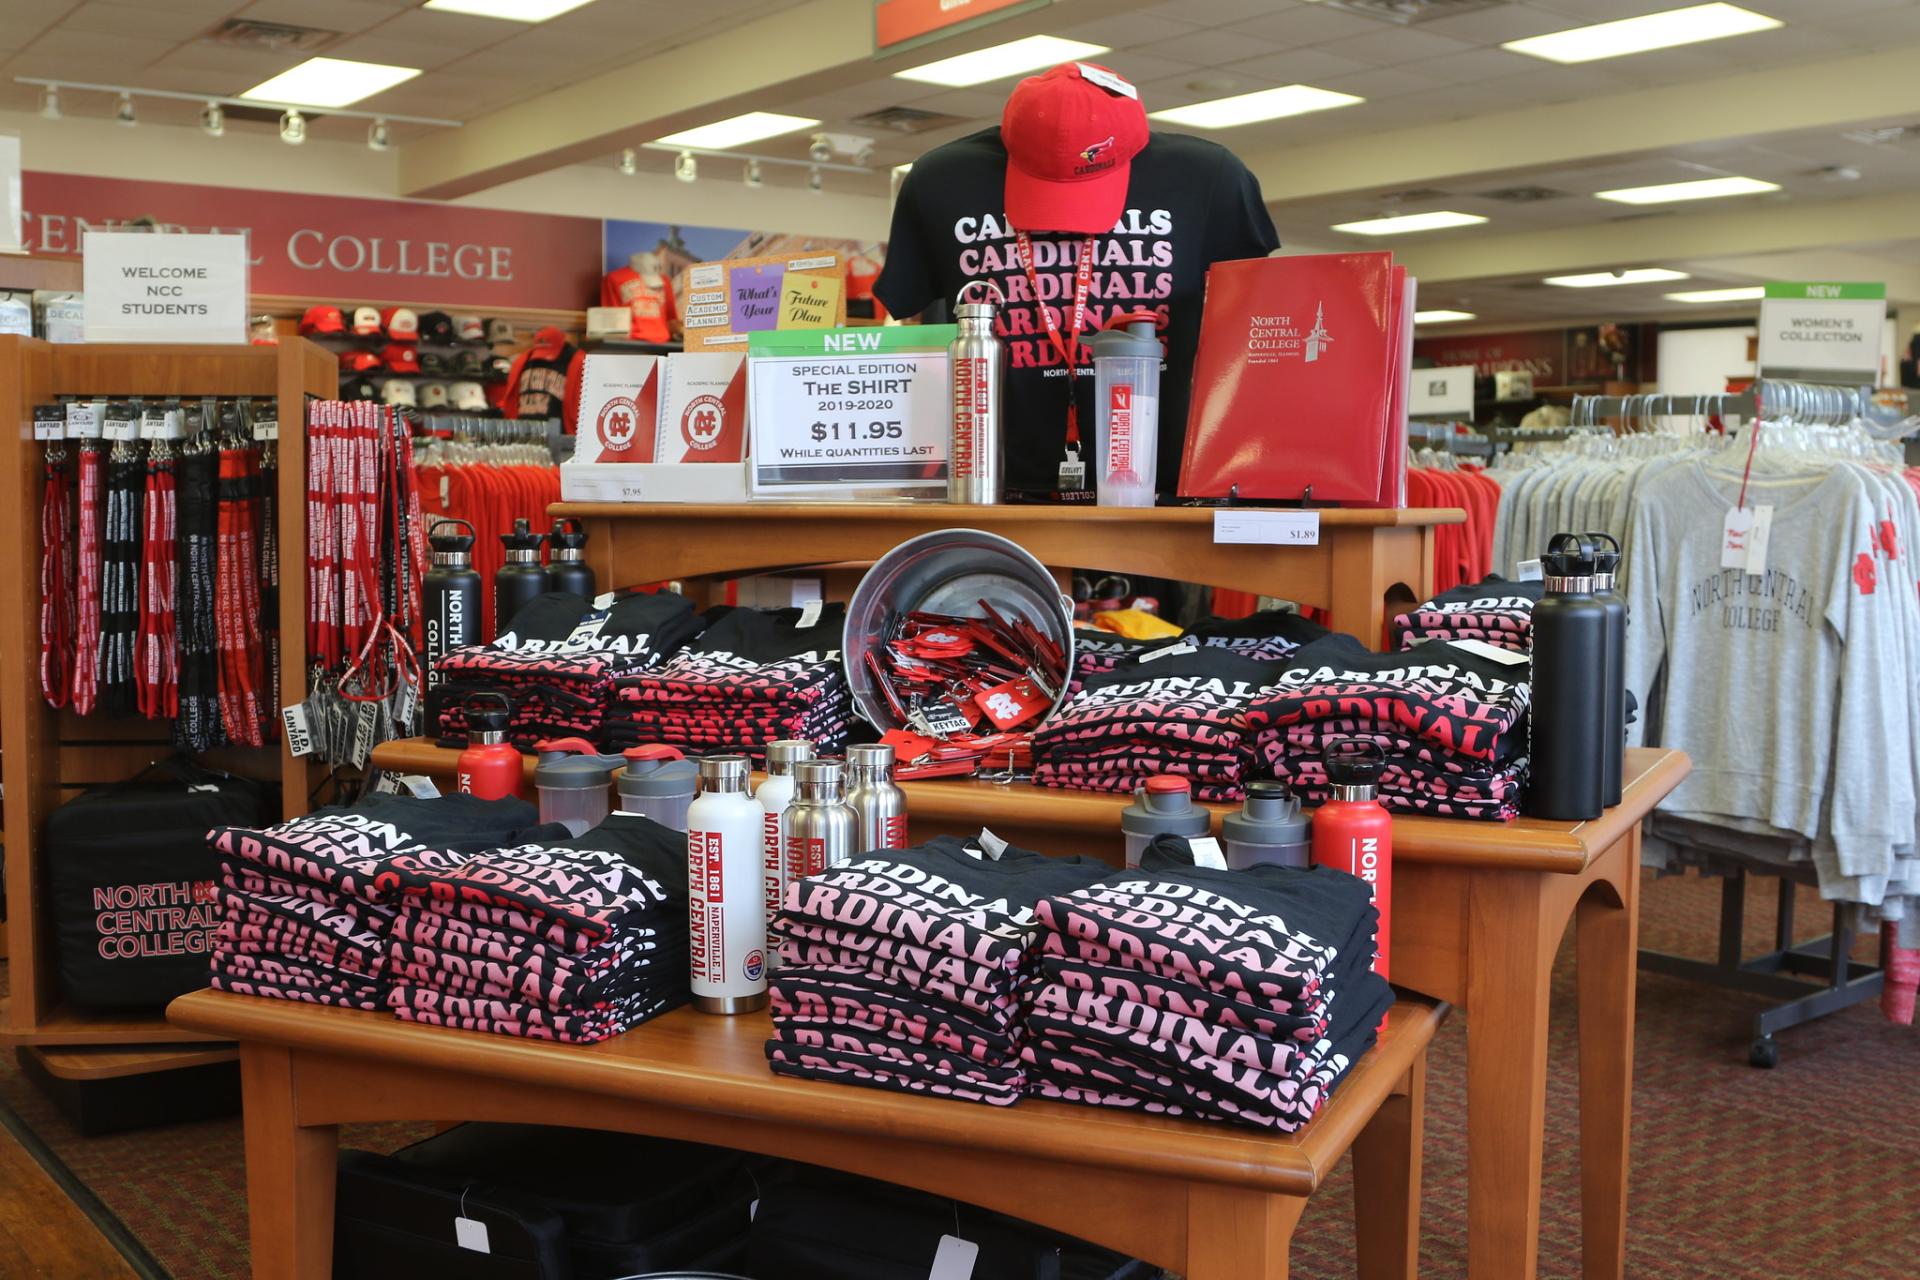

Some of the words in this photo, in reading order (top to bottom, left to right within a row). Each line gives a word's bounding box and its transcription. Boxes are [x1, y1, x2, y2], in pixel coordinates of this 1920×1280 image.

[954, 208, 1174, 244] CAALS
[287, 229, 514, 281] COLLEGE
[959, 238, 1174, 276] CARDINALS
[122, 267, 207, 279] WELCOME
[146, 286, 182, 297] NCC
[1806, 285, 1841, 297] NEW
[122, 304, 208, 315] STUDENTS
[740, 304, 774, 320] Your
[788, 307, 822, 323] Plan
[1074, 284, 1089, 330] NORTH
[1250, 316, 1290, 326] NORTH
[823, 333, 882, 352] NEW
[1248, 339, 1300, 350] COLLEGE
[1249, 328, 1301, 338] CENTRAL
[1779, 331, 1863, 342] COLLECTION
[792, 365, 855, 376] SPECIAL
[858, 363, 917, 374] EDITION
[955, 358, 972, 407] NORTH
[847, 379, 912, 395] SHIRT
[600, 398, 618, 418] NORTH
[619, 398, 640, 418] CENTRAL
[685, 396, 704, 417] NORTH
[704, 396, 726, 416] CENTRAL
[817, 399, 893, 411] 2019-2020
[604, 441, 632, 451] COLLEGE
[689, 440, 717, 450] COLLEGE
[810, 420, 903, 443] $11.95
[955, 412, 972, 479] CENTRAL
[825, 447, 900, 458] QUANTITIES
[903, 446, 935, 455] LAST
[622, 488, 641, 497] $7.95
[1290, 529, 1316, 539] $1.89
[190, 543, 199, 572] NORTH
[220, 542, 229, 571] NORTH
[221, 572, 230, 611] CENTRAL
[1417, 596, 1535, 615] ARDIN
[1692, 567, 1746, 616] NORTH
[223, 612, 233, 650] COLLEGE
[233, 613, 245, 650] COLLEGE
[449, 589, 463, 645] NORTH
[1722, 606, 1781, 632] COLLEGE
[492, 631, 651, 655] ARDNAL
[434, 653, 602, 677] ARDINAL
[1074, 677, 1255, 701] ARDINAL
[284, 710, 301, 753] LANYARD
[932, 719, 967, 731] KEYTAG
[1246, 697, 1498, 762] CRDINAL
[297, 729, 309, 751] I.D.
[707, 838, 719, 865] EST.
[764, 812, 780, 871] NORTH
[689, 829, 704, 892] NORTH
[810, 844, 822, 871] EST.
[93, 881, 191, 910] NORTH
[709, 869, 721, 897] 1861
[829, 857, 1040, 927] ARDINAL
[96, 905, 221, 935] CENTRAL
[765, 876, 781, 955] CENAL
[804, 871, 1024, 940] ARDINAL
[1089, 880, 1325, 952] ARDINAL
[402, 895, 590, 954] ARDINAL
[690, 897, 706, 979] CENTRAL
[783, 882, 1005, 970] ARDINAL
[1052, 896, 1302, 978] ARDINAL
[1068, 889, 1319, 962] ARDINAL
[389, 914, 573, 987] ARDINAL
[1033, 899, 1283, 997] ARDINAL
[389, 941, 567, 1006] ARDINAL
[387, 986, 571, 1033] ARDINAL
[1033, 983, 1298, 1078] ARDINAL
